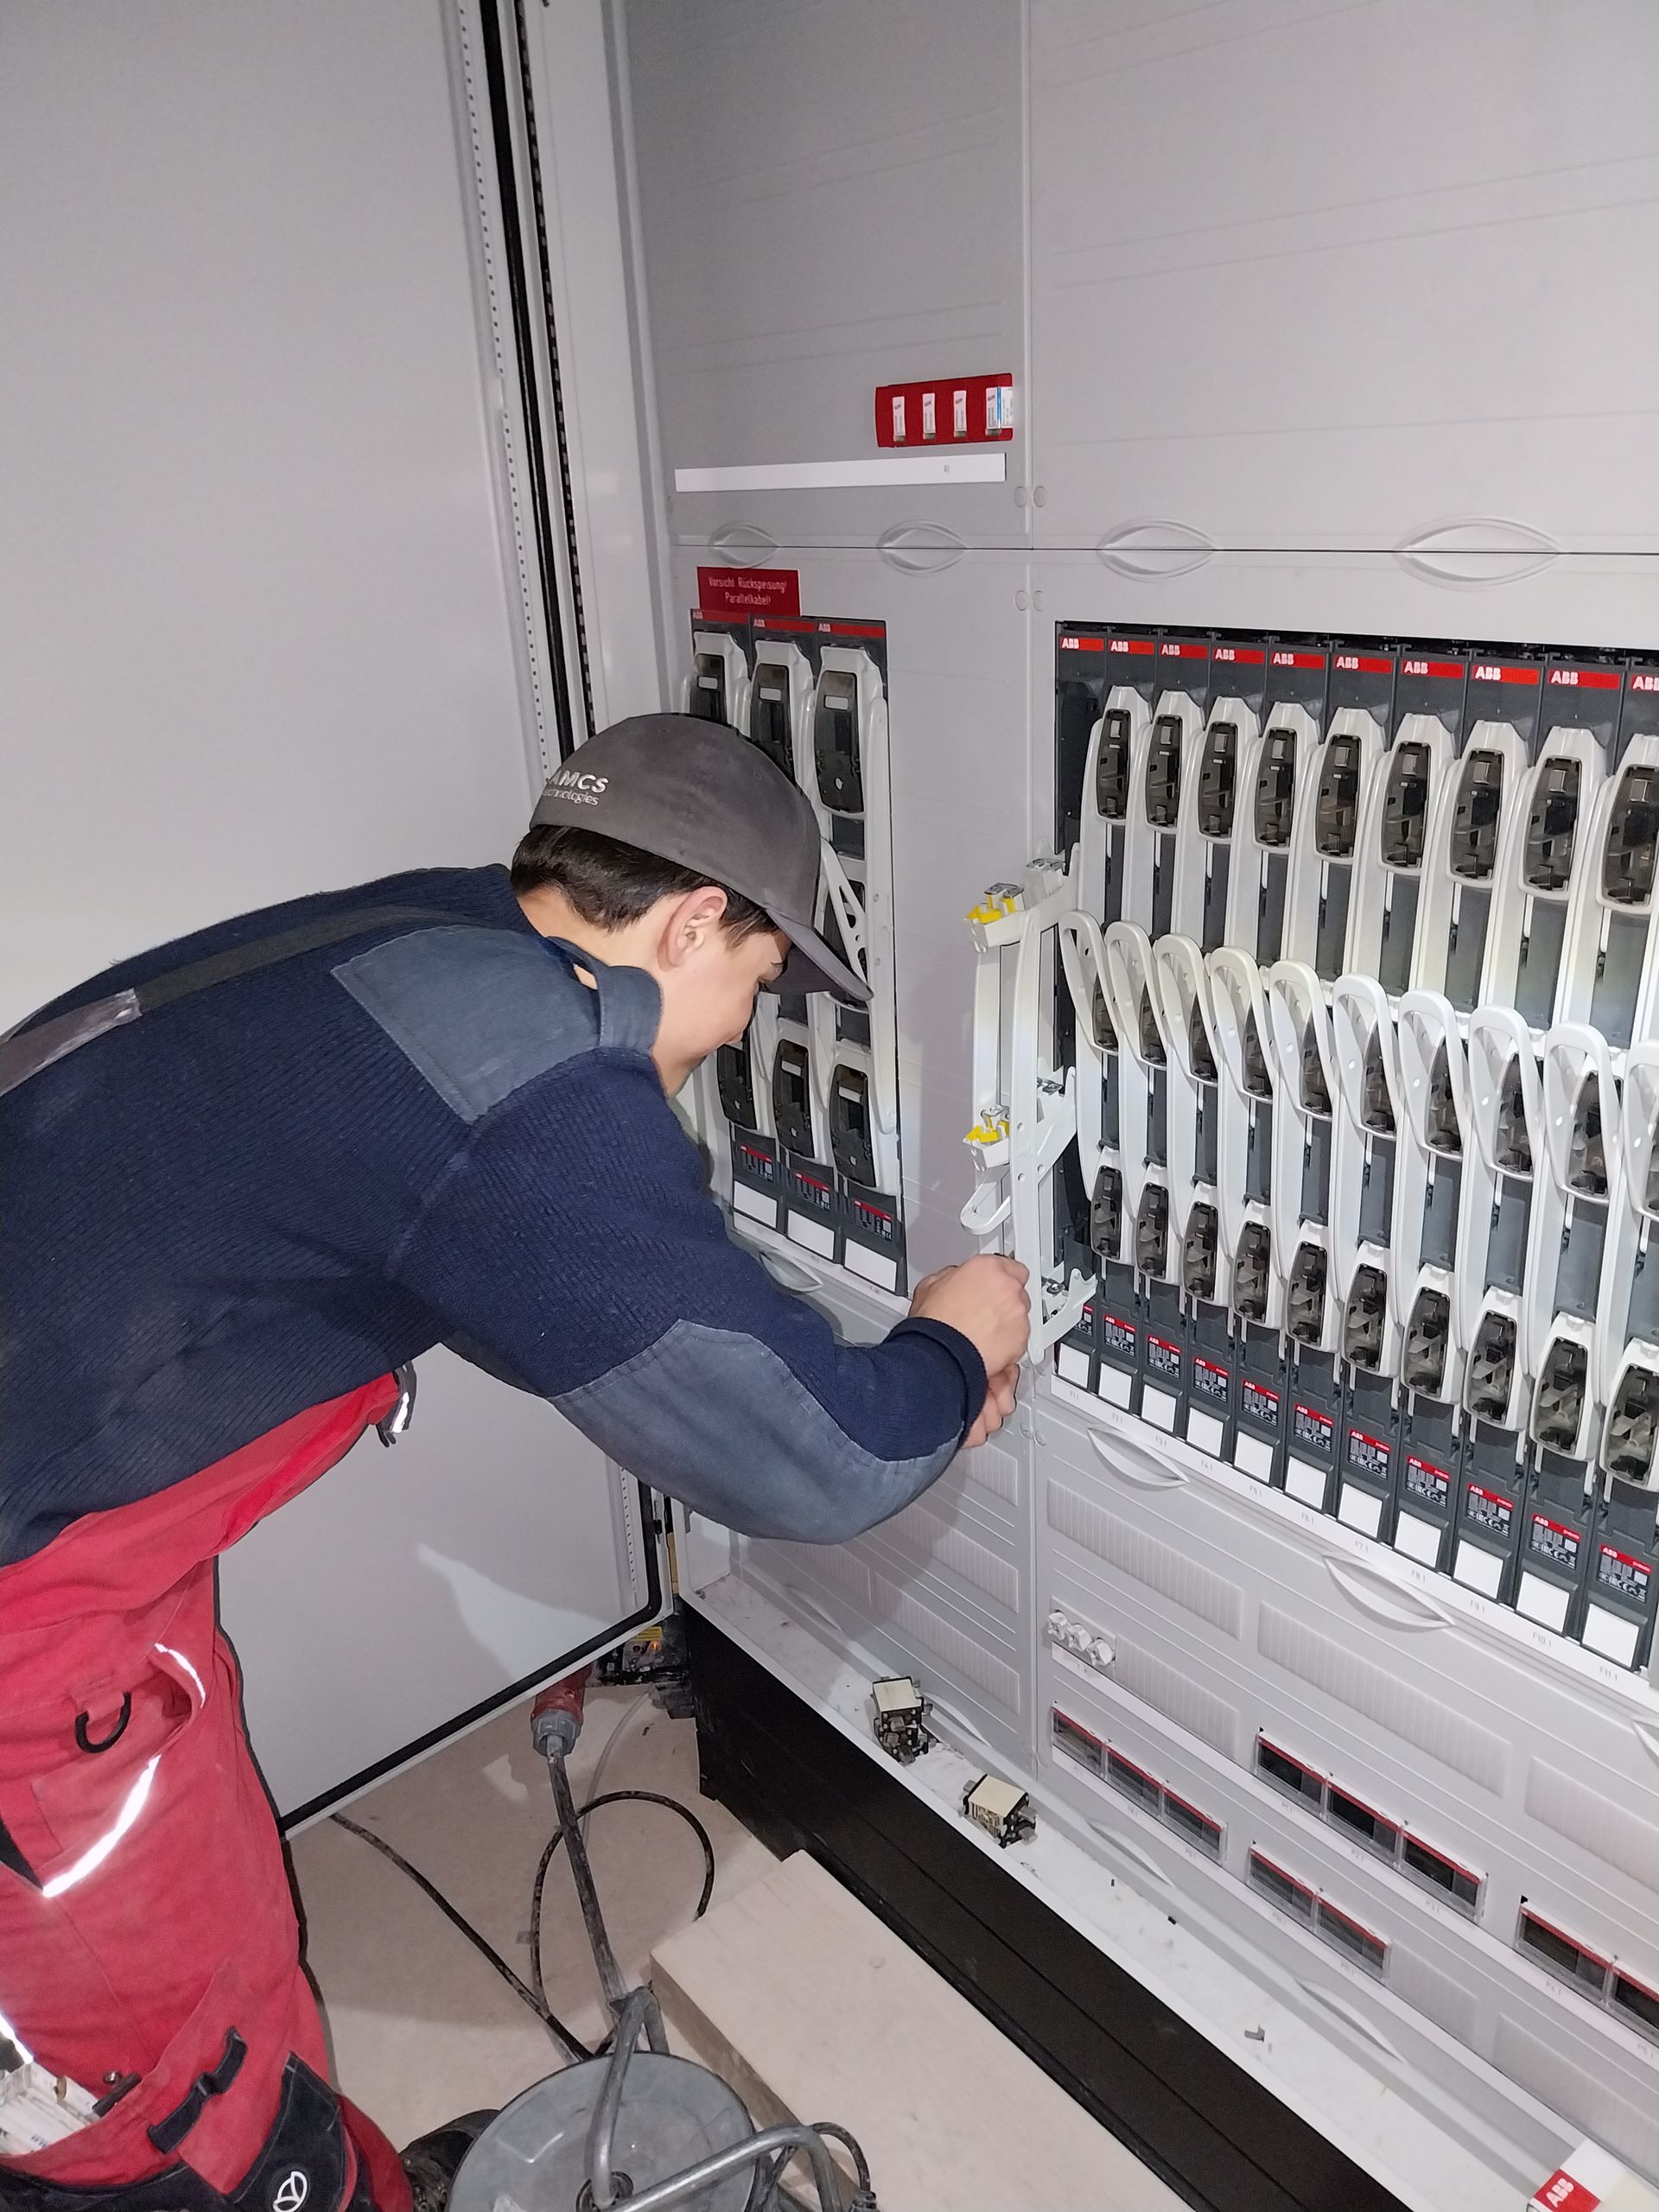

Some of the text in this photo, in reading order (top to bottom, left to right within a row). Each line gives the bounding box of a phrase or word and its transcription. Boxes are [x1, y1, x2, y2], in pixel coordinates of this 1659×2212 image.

[1062, 638, 1079, 649] ABB
[1110, 640, 1129, 652] ABB
[1161, 644, 1180, 656] ABB
[1215, 649, 1235, 661] ABB
[1273, 652, 1294, 665] ABB
[1336, 657, 1359, 670] ABB
[1403, 661, 1428, 675] ABB
[1475, 666, 1501, 681] ABB
[1550, 671, 1579, 685] ABB
[1470, 1485, 1484, 1496] ABB
[1535, 1516, 1549, 1527] ABB
[1603, 1547, 1618, 1559] ABB
[1546, 2177, 1574, 2208] ABB
